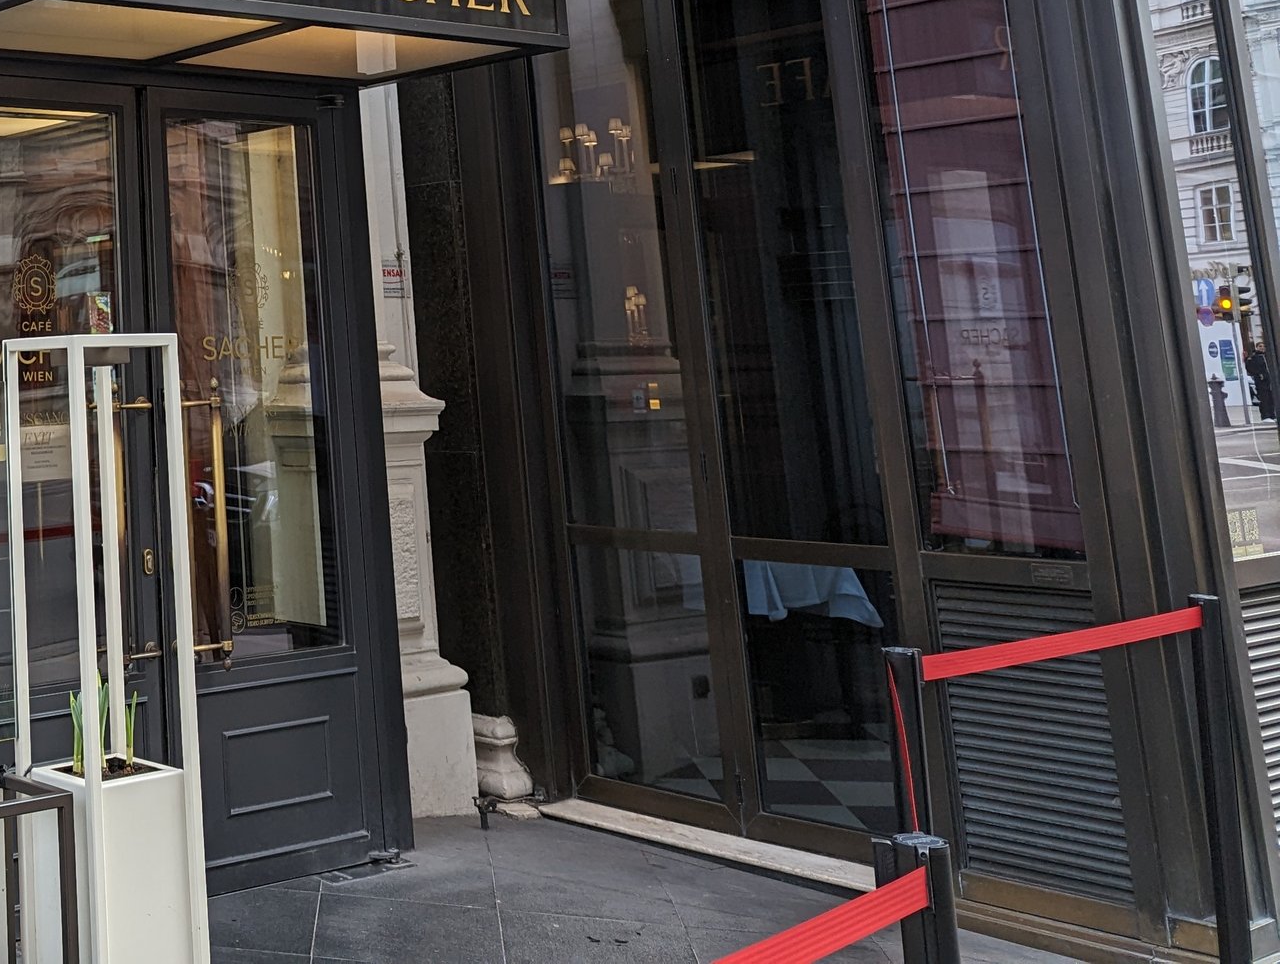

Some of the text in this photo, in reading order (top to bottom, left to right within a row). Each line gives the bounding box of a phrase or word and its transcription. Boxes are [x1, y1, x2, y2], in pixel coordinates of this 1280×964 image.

[30, 276, 42, 297] S
[22, 319, 52, 332] CAFÉ
[202, 335, 299, 362] SACHER
[22, 371, 53, 382] WIEN
